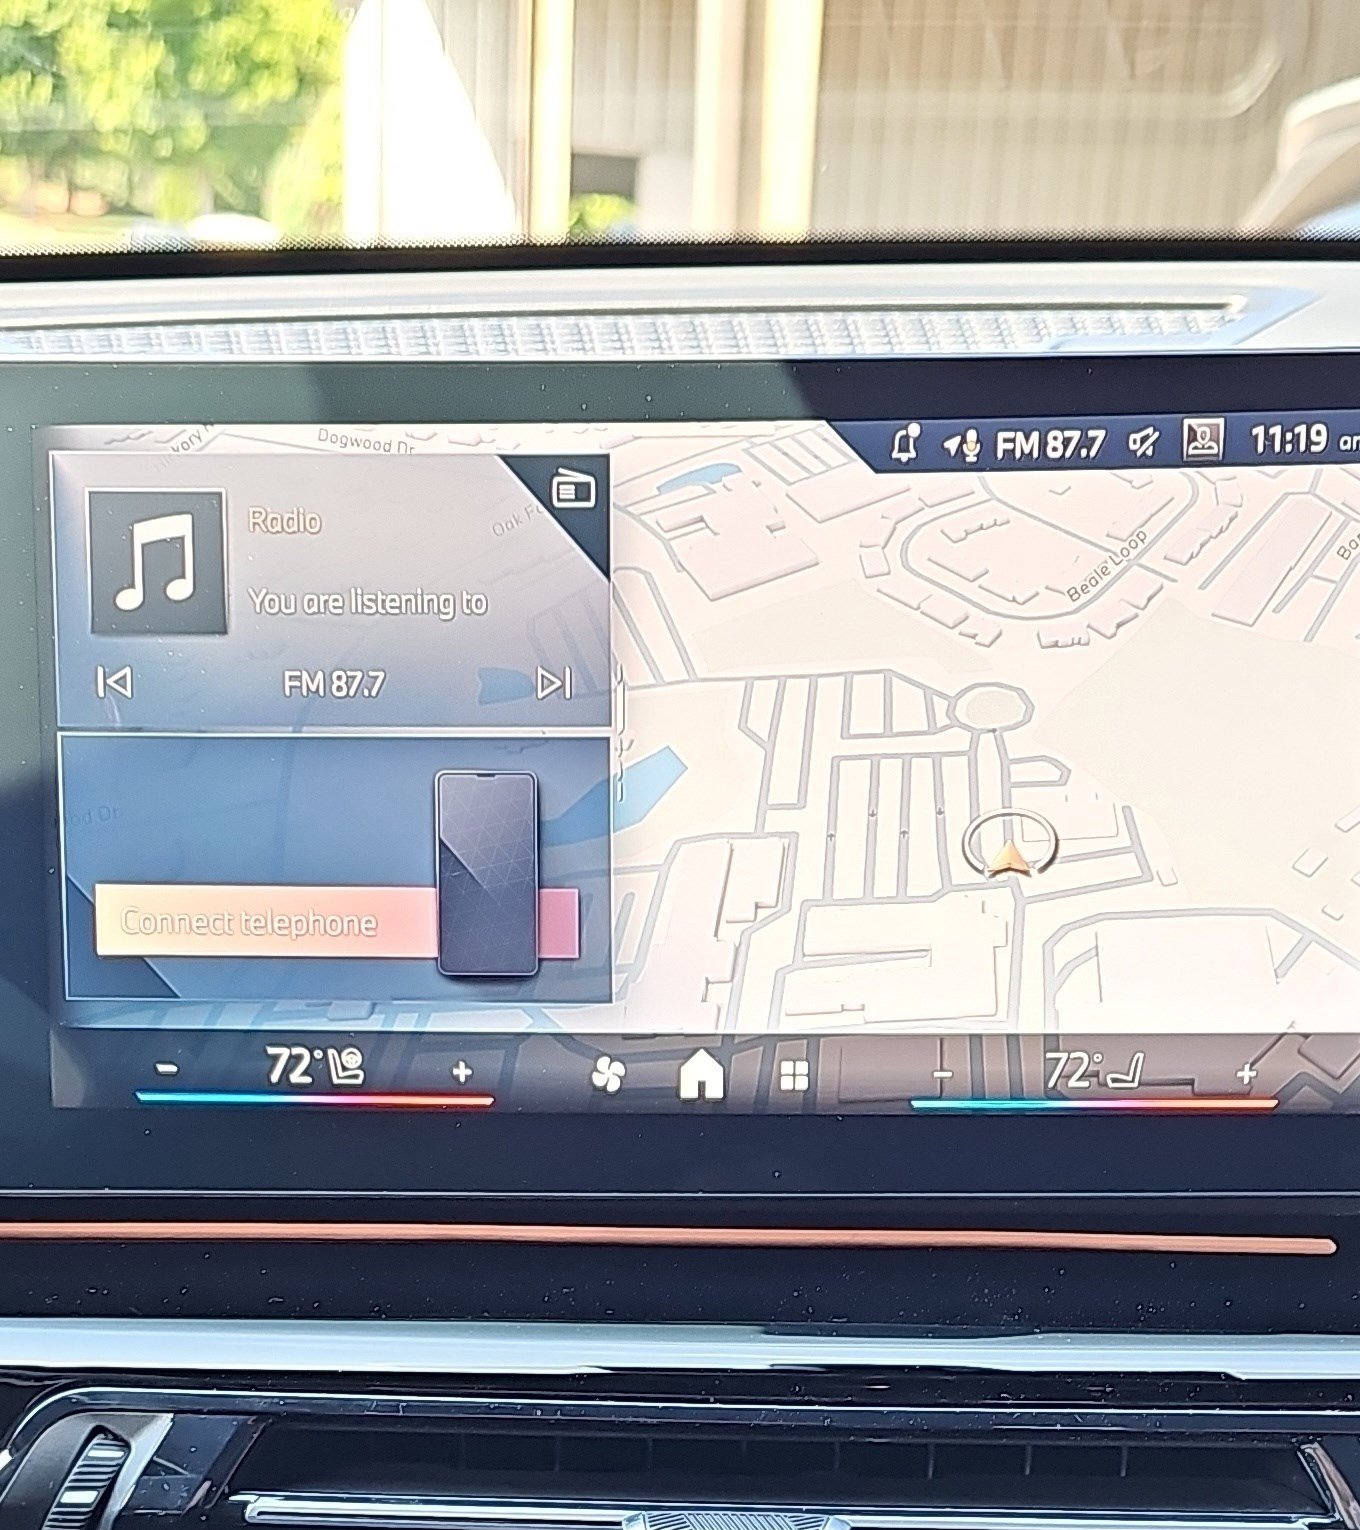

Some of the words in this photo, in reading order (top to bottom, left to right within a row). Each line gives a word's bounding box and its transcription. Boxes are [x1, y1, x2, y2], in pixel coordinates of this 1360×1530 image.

[318, 428, 392, 453] Dogwood
[996, 431, 1039, 460] FM
[1046, 430, 1106, 458] 87.7
[1251, 424, 1329, 455] 11:19
[247, 506, 322, 534] Radio
[492, 512, 522, 537] Oak
[1066, 565, 1111, 602] Beale
[1108, 530, 1147, 566] Loop
[247, 587, 296, 615] You
[303, 593, 344, 615] are
[350, 587, 455, 621] listening
[461, 589, 488, 615] to
[283, 670, 325, 697] FM
[331, 670, 386, 697] 87.7
[121, 906, 234, 935] Connect
[240, 907, 379, 940] telephone
[265, 1045, 324, 1084] 72°
[1045, 1051, 1103, 1088] 72°
